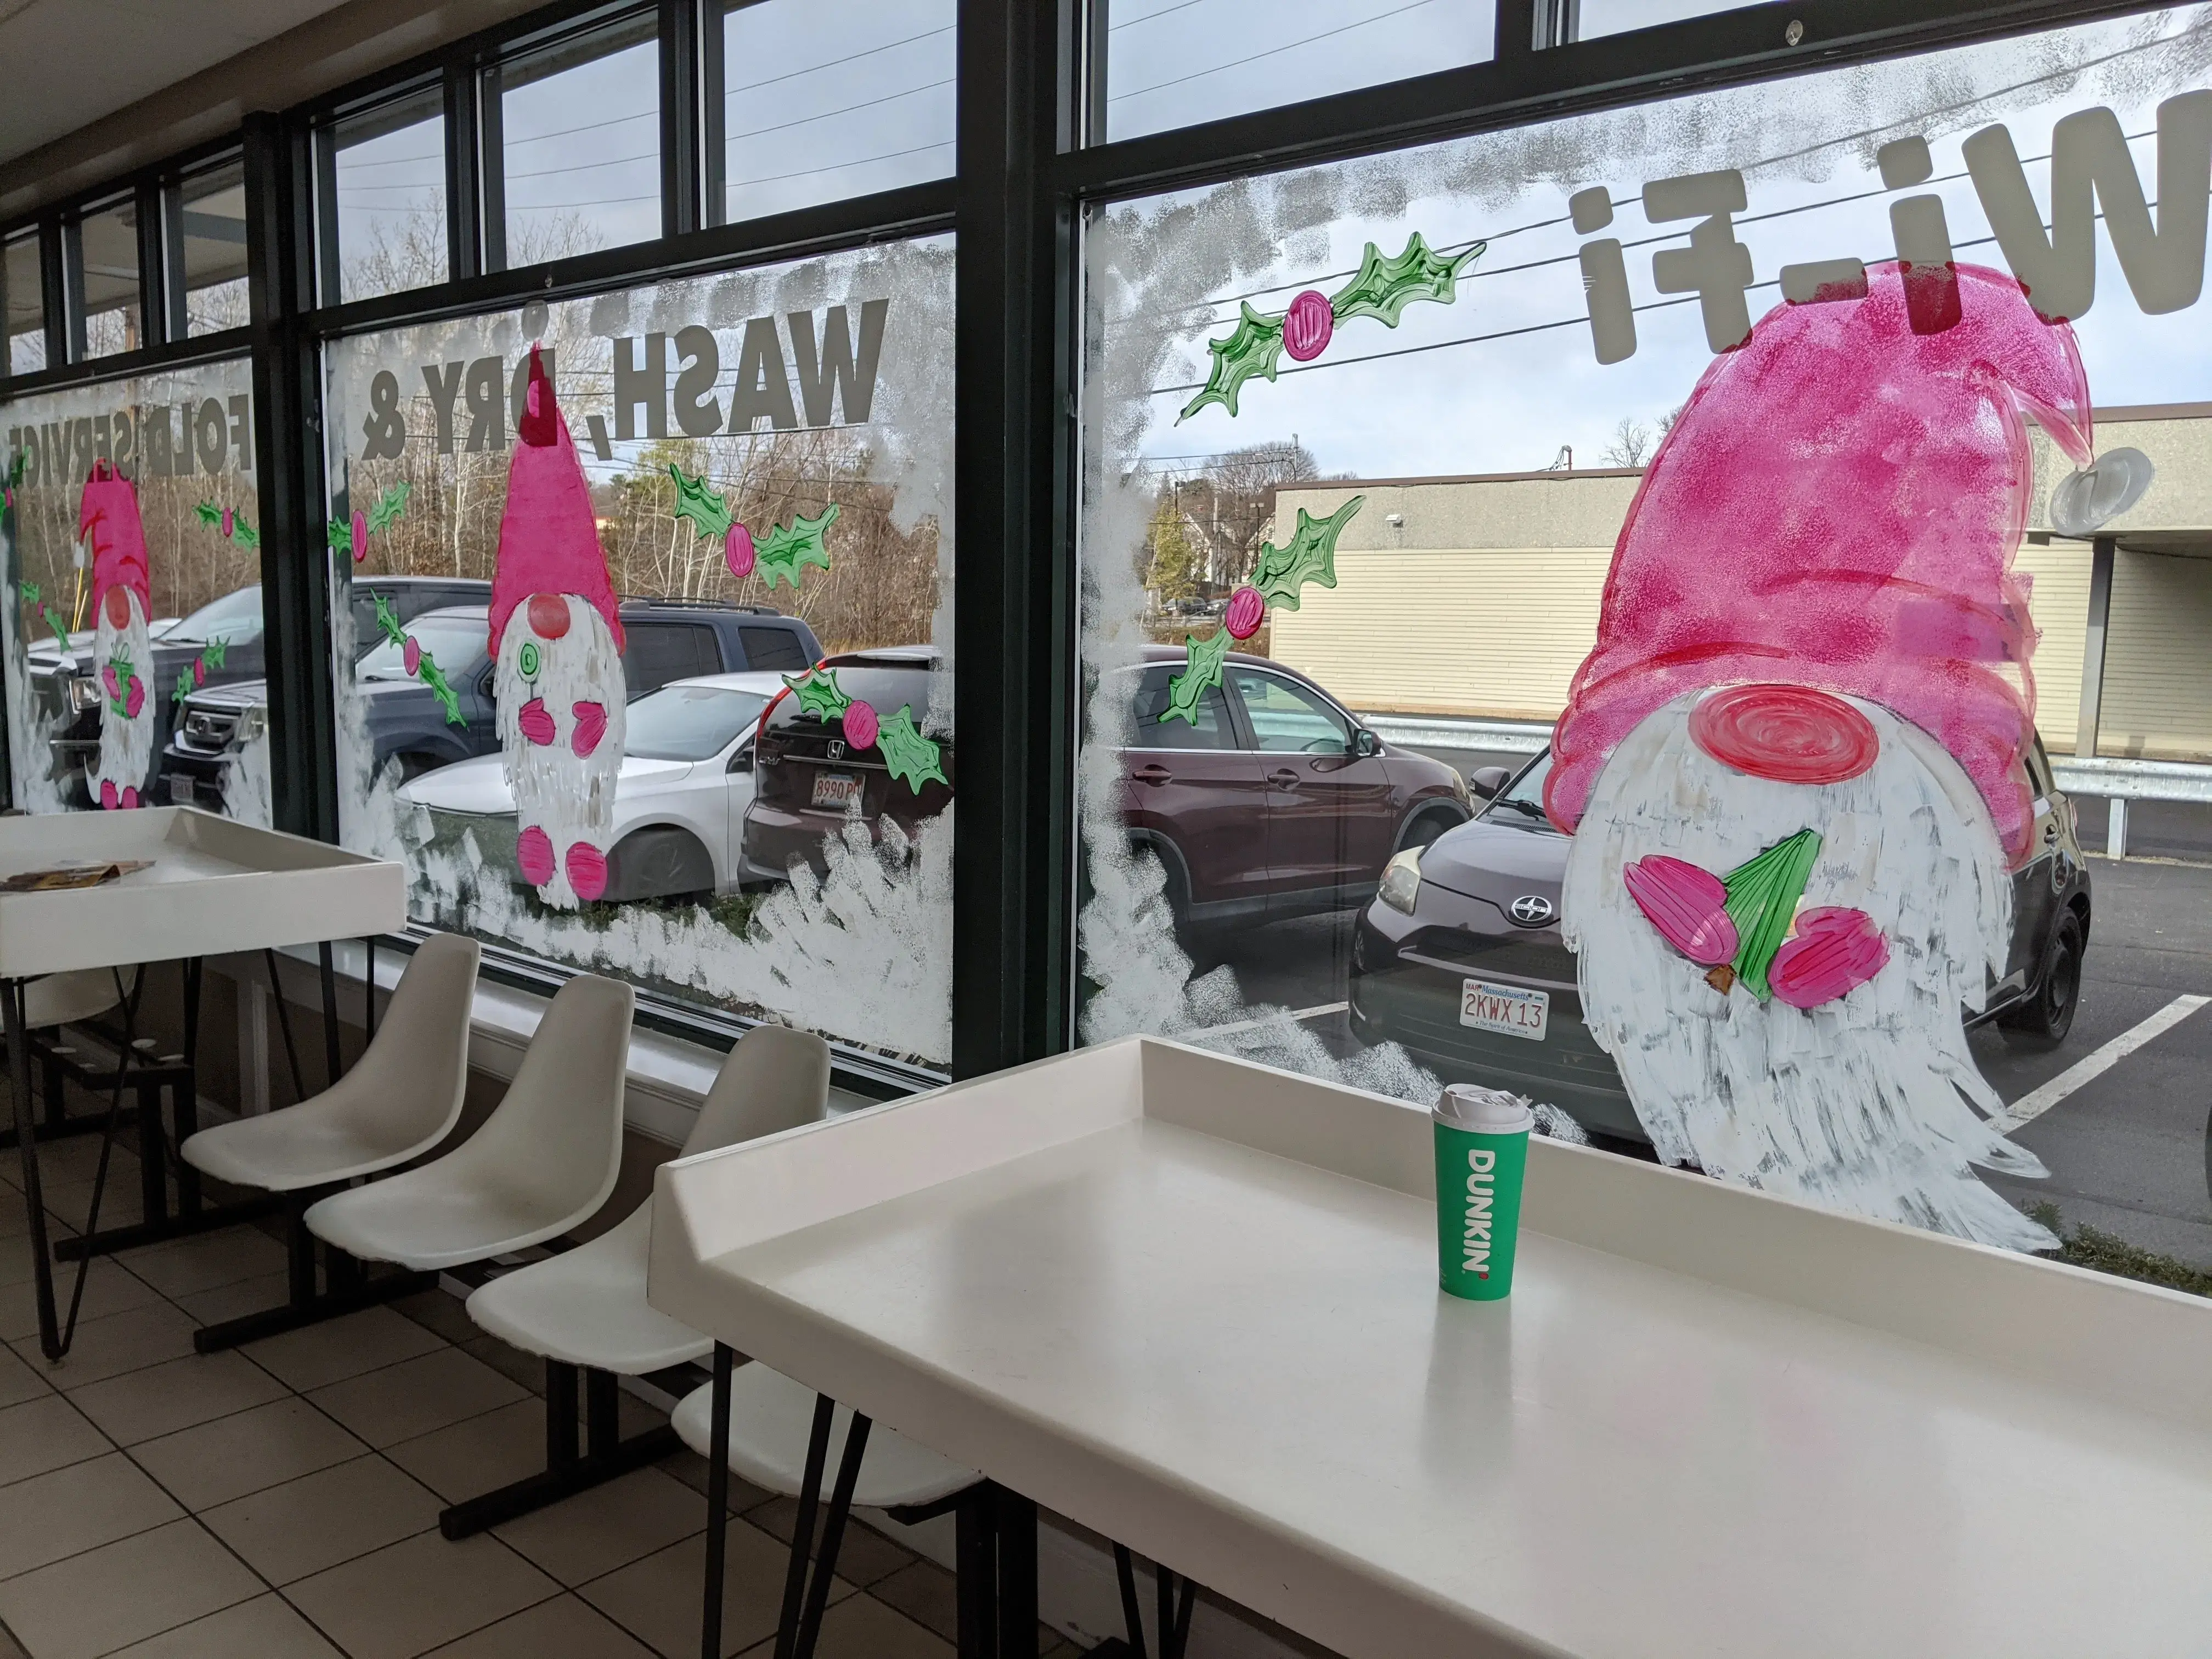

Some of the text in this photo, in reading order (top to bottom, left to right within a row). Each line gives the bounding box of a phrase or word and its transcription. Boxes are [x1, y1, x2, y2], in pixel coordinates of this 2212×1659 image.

[817, 780, 843, 799] 8990
[1515, 904, 1547, 913] SCION
[1482, 985, 1529, 1001] Massachusetts
[1465, 993, 1543, 1028] 2KWX 13
